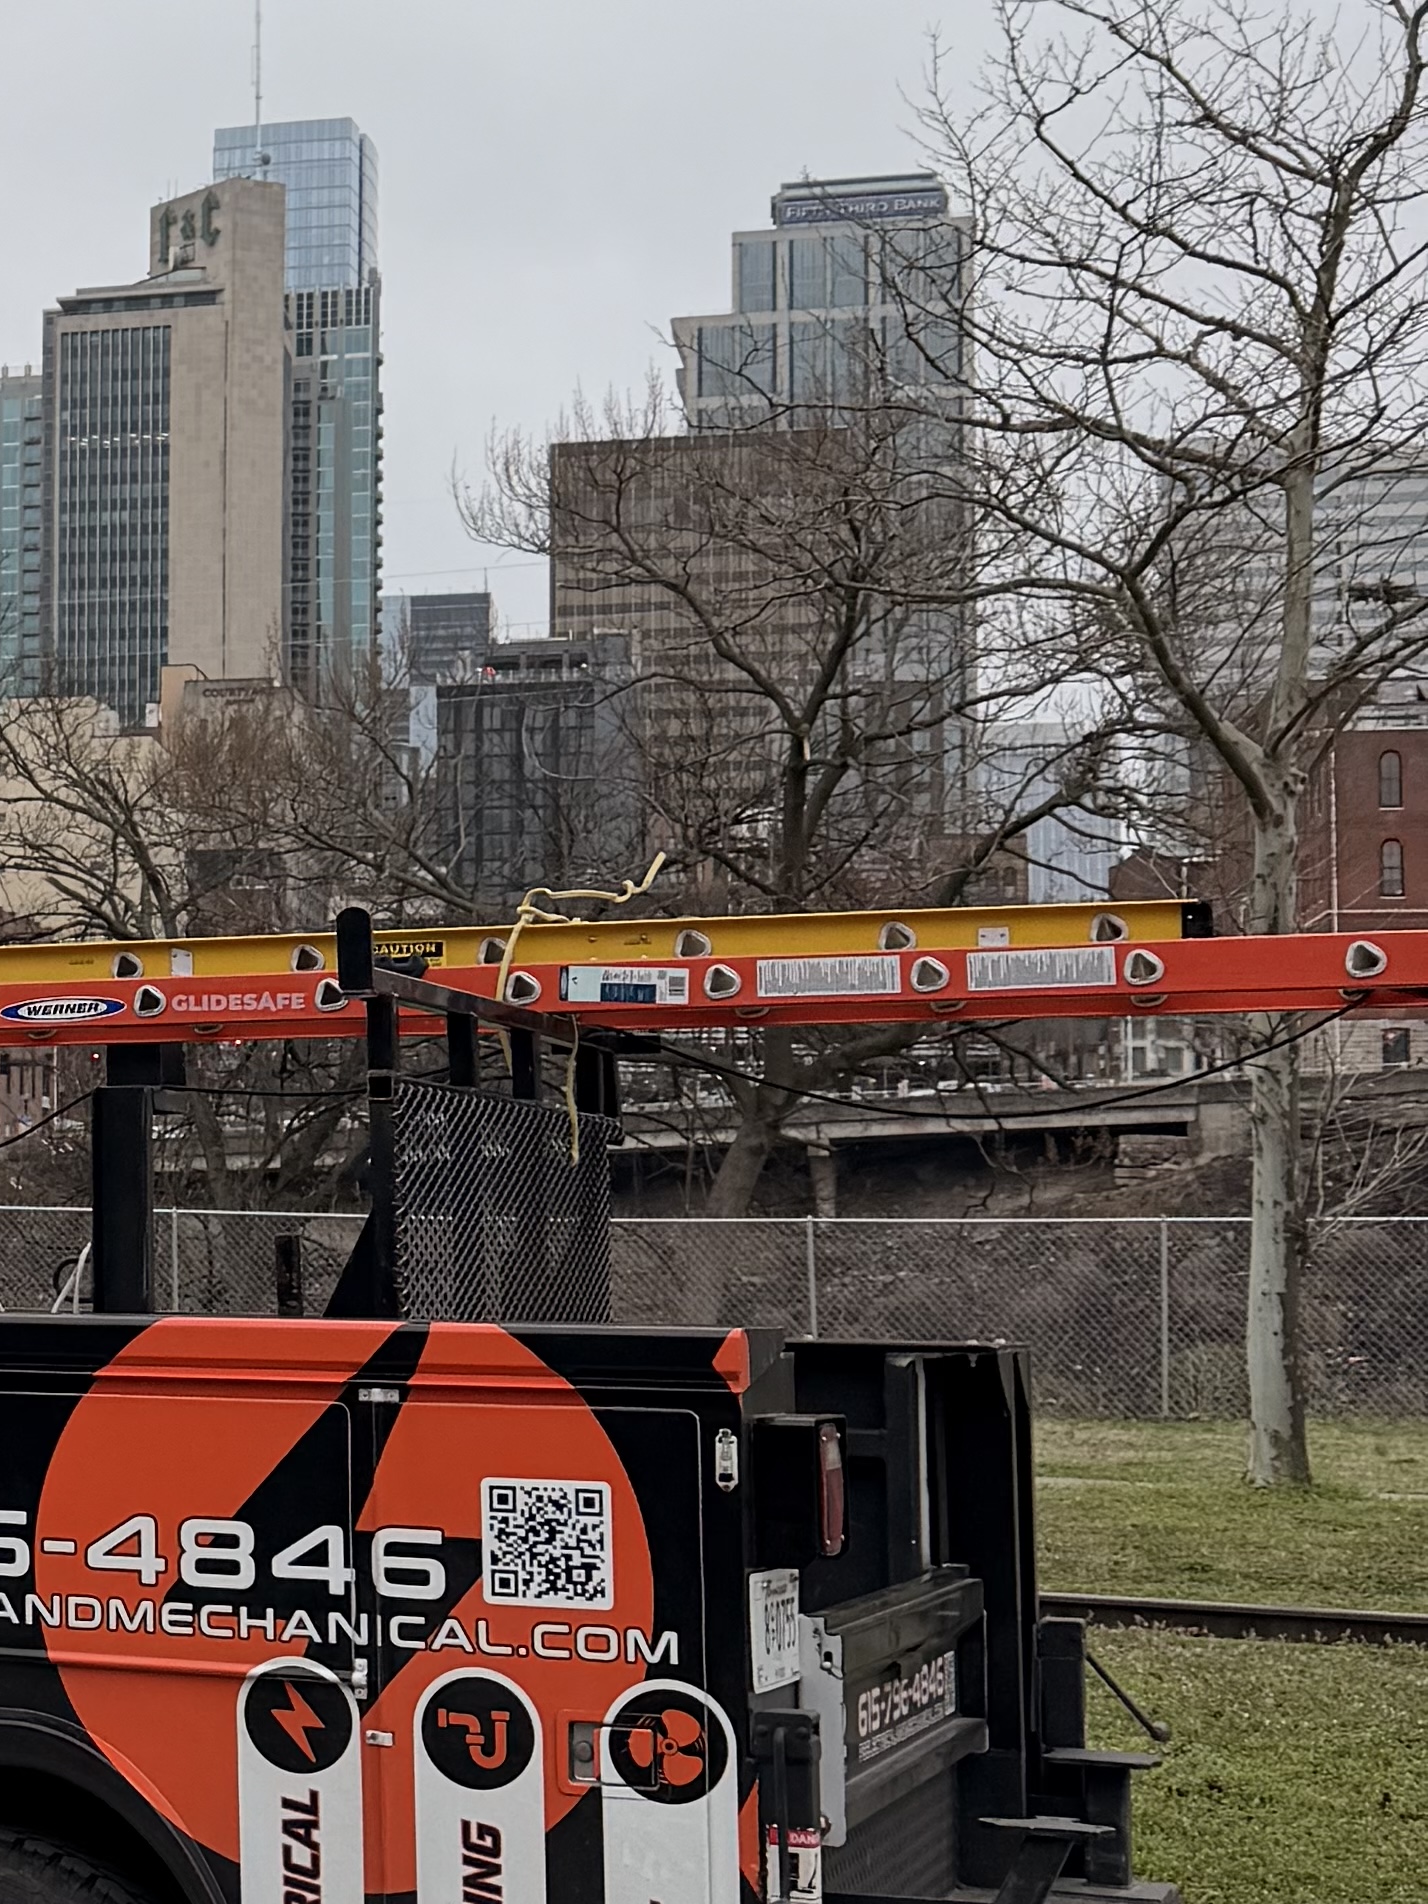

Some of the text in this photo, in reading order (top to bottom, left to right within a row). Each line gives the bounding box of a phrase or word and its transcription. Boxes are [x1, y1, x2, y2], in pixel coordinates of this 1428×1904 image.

[894, 198, 941, 211] BANK
[26, 1002, 100, 1017] WERNER
[172, 992, 306, 1012] GLIDESAFE
